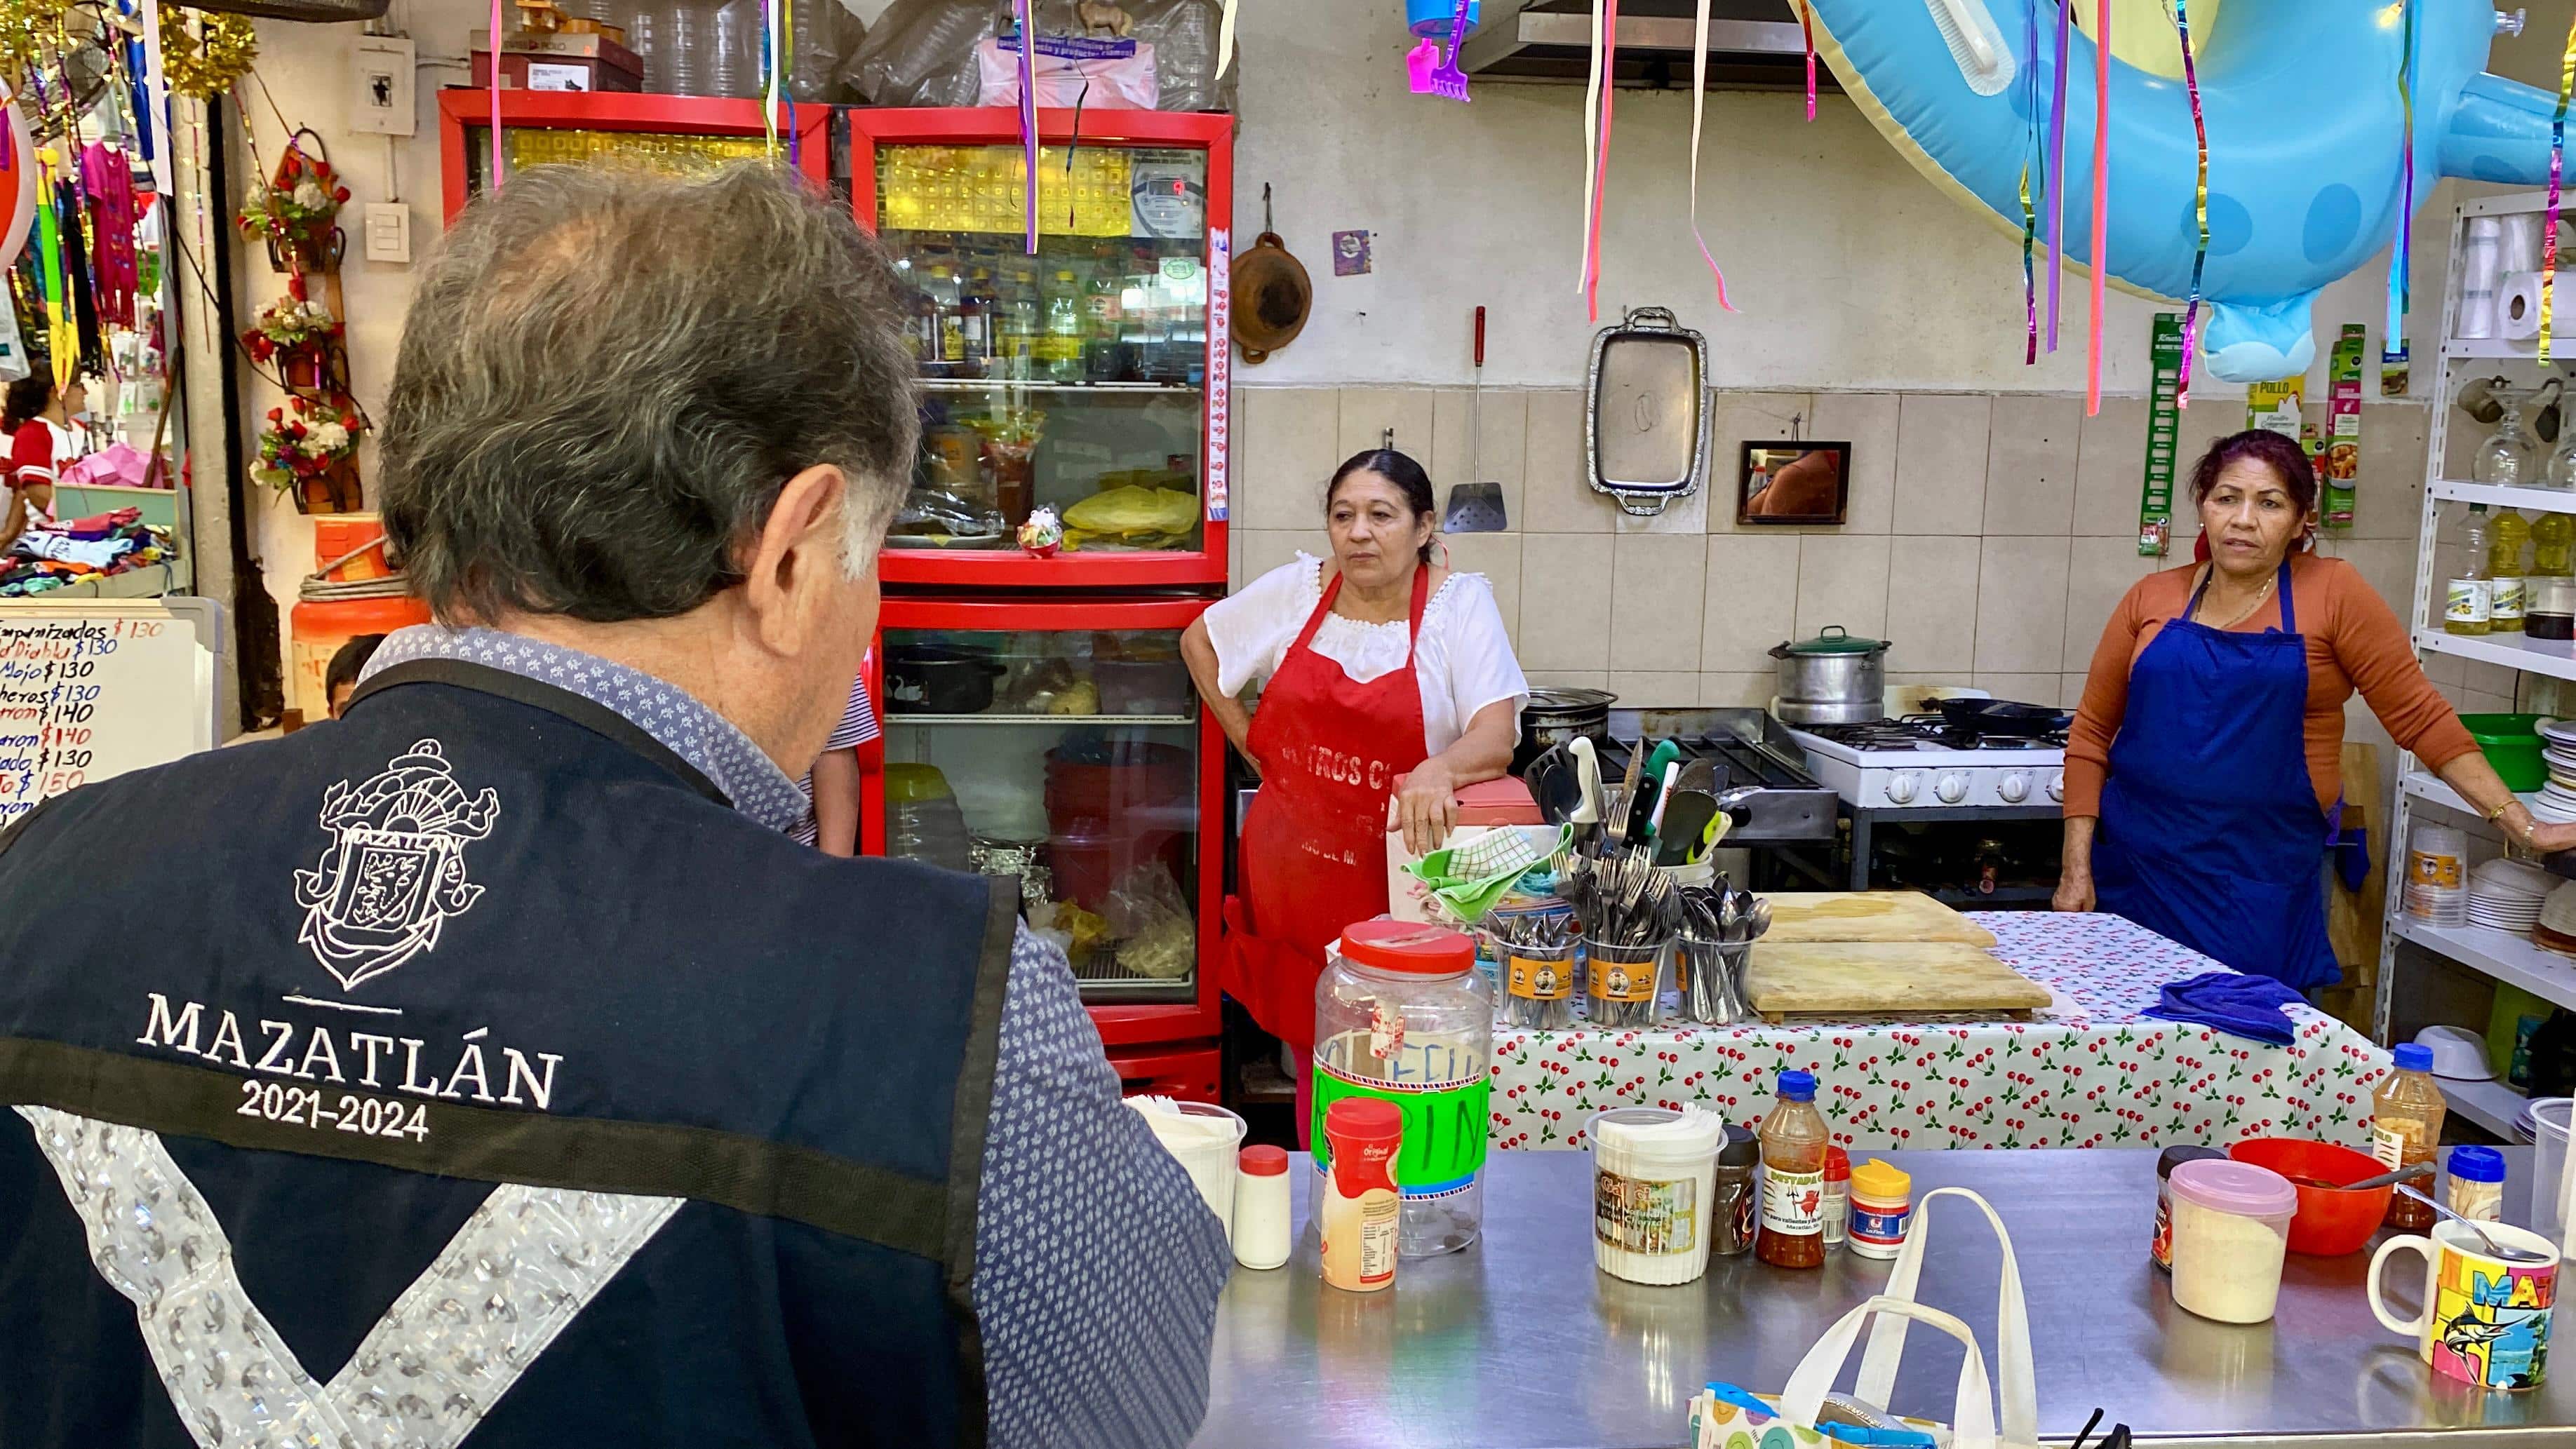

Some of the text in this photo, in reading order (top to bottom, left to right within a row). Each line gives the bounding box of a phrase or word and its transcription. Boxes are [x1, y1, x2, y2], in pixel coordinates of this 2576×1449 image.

[2260, 382, 2289, 393] POLLO
[136, 992, 563, 1110] MAZATLÁN
[237, 1079, 429, 1142] 2021-2024
[1363, 1146, 1389, 1157] Original
